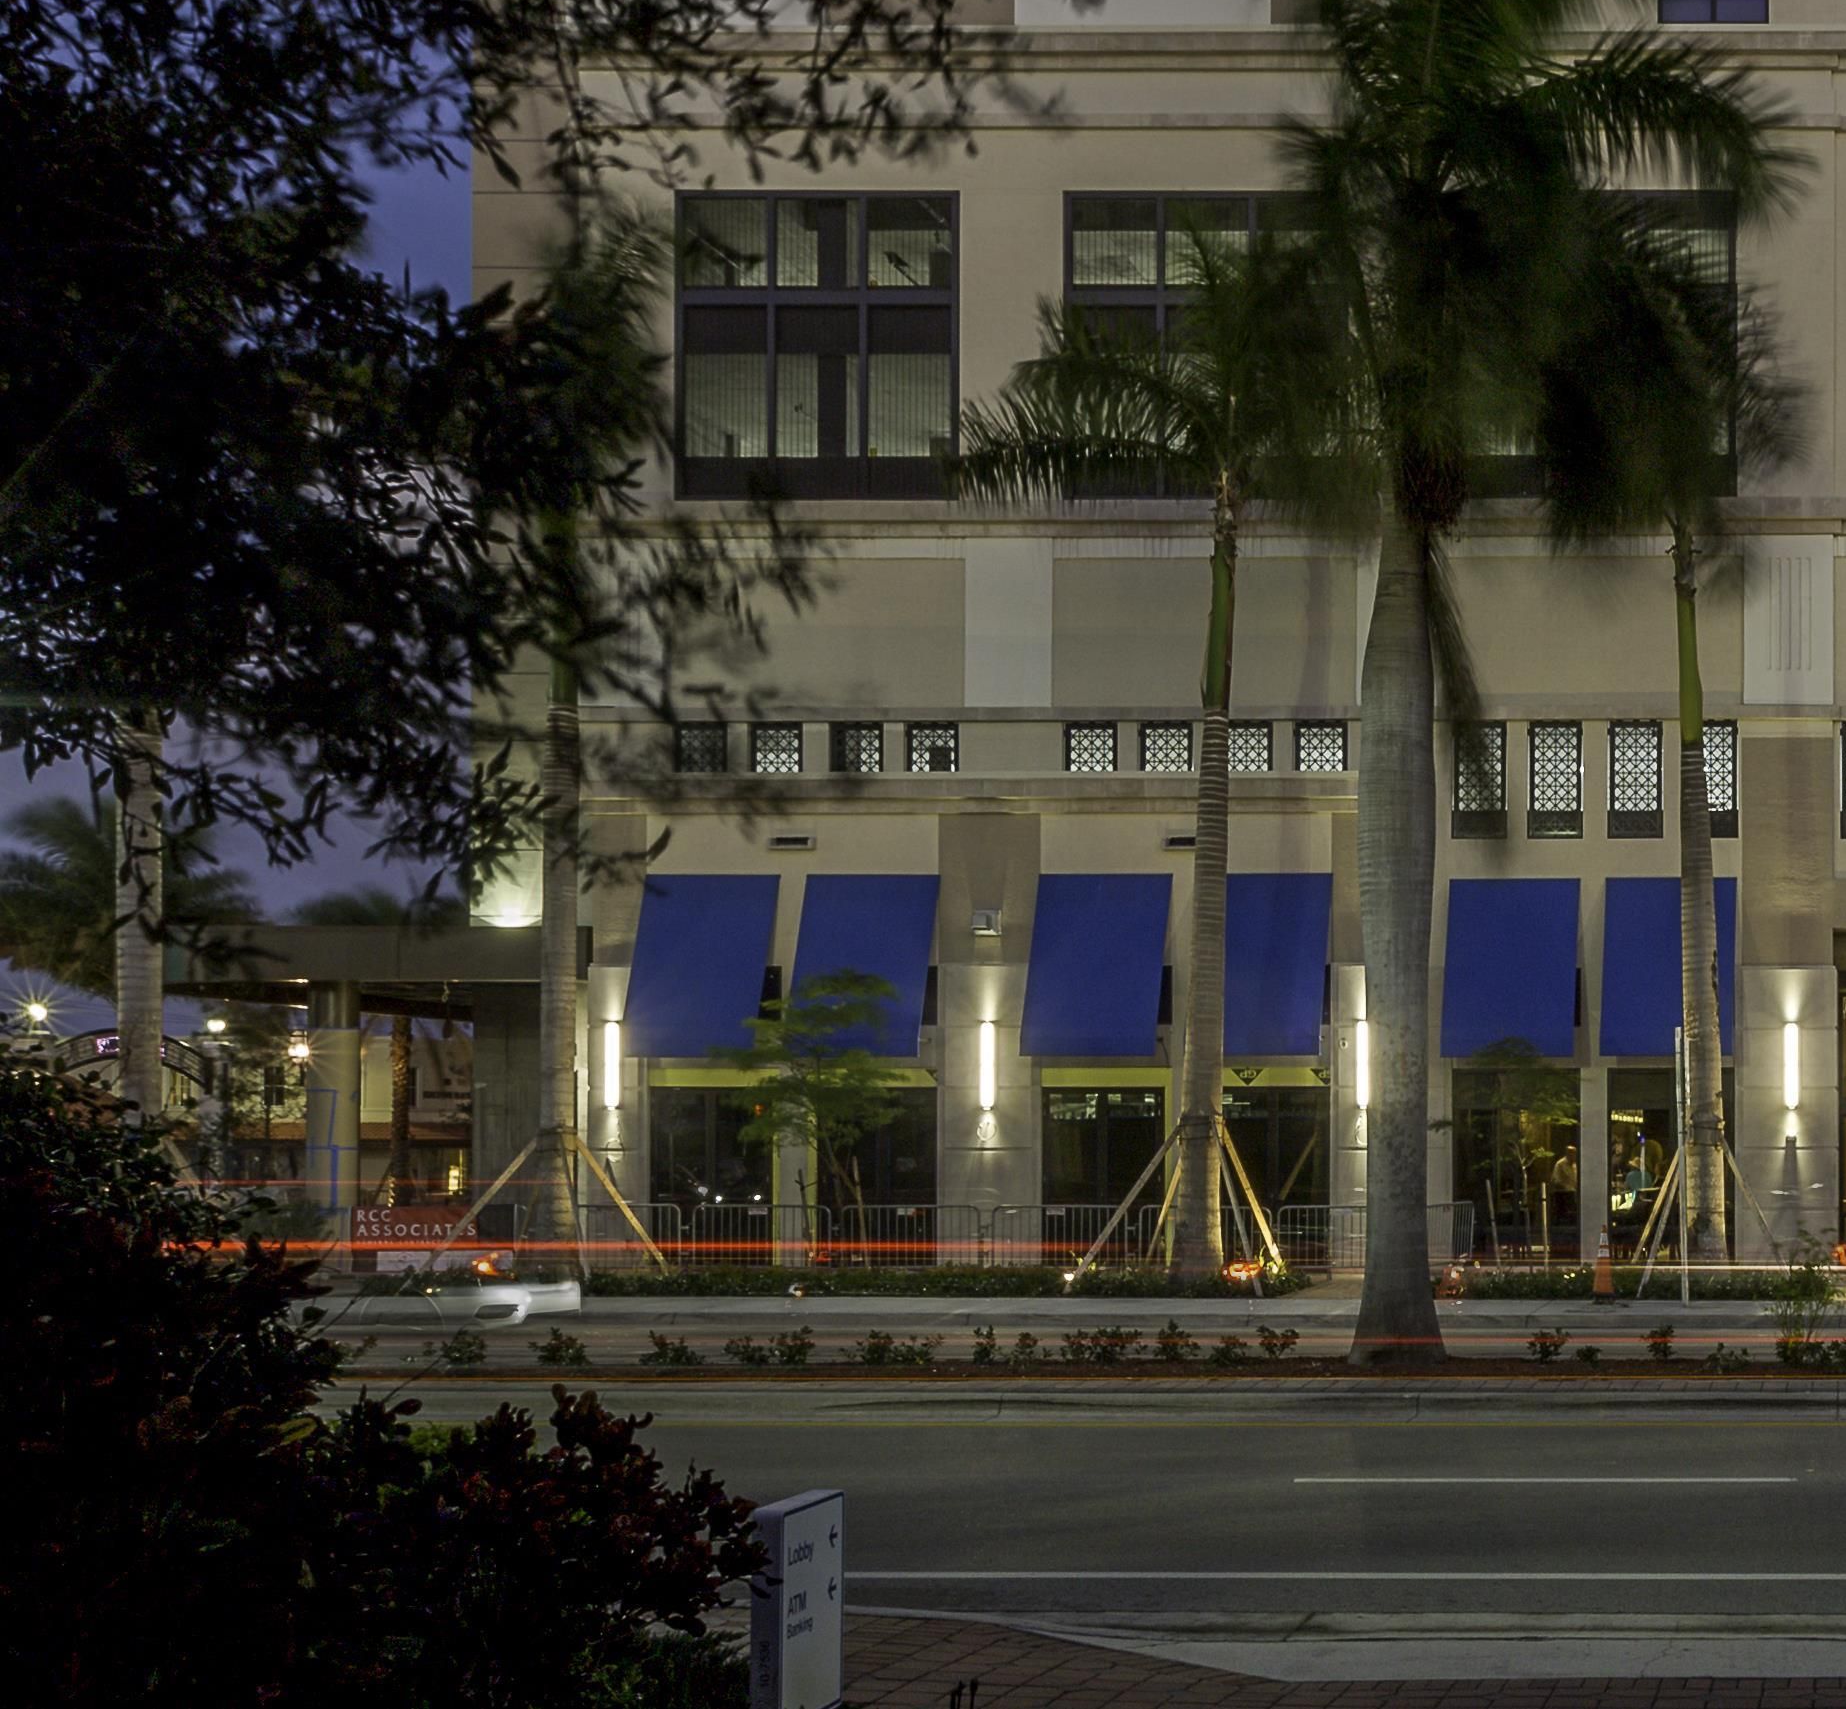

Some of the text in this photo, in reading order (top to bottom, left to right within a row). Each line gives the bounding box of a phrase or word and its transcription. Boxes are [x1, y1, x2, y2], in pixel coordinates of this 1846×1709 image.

[356, 1209, 391, 1222] RCC
[787, 1540, 815, 1567] Lobby
[787, 1590, 807, 1617] ATM
